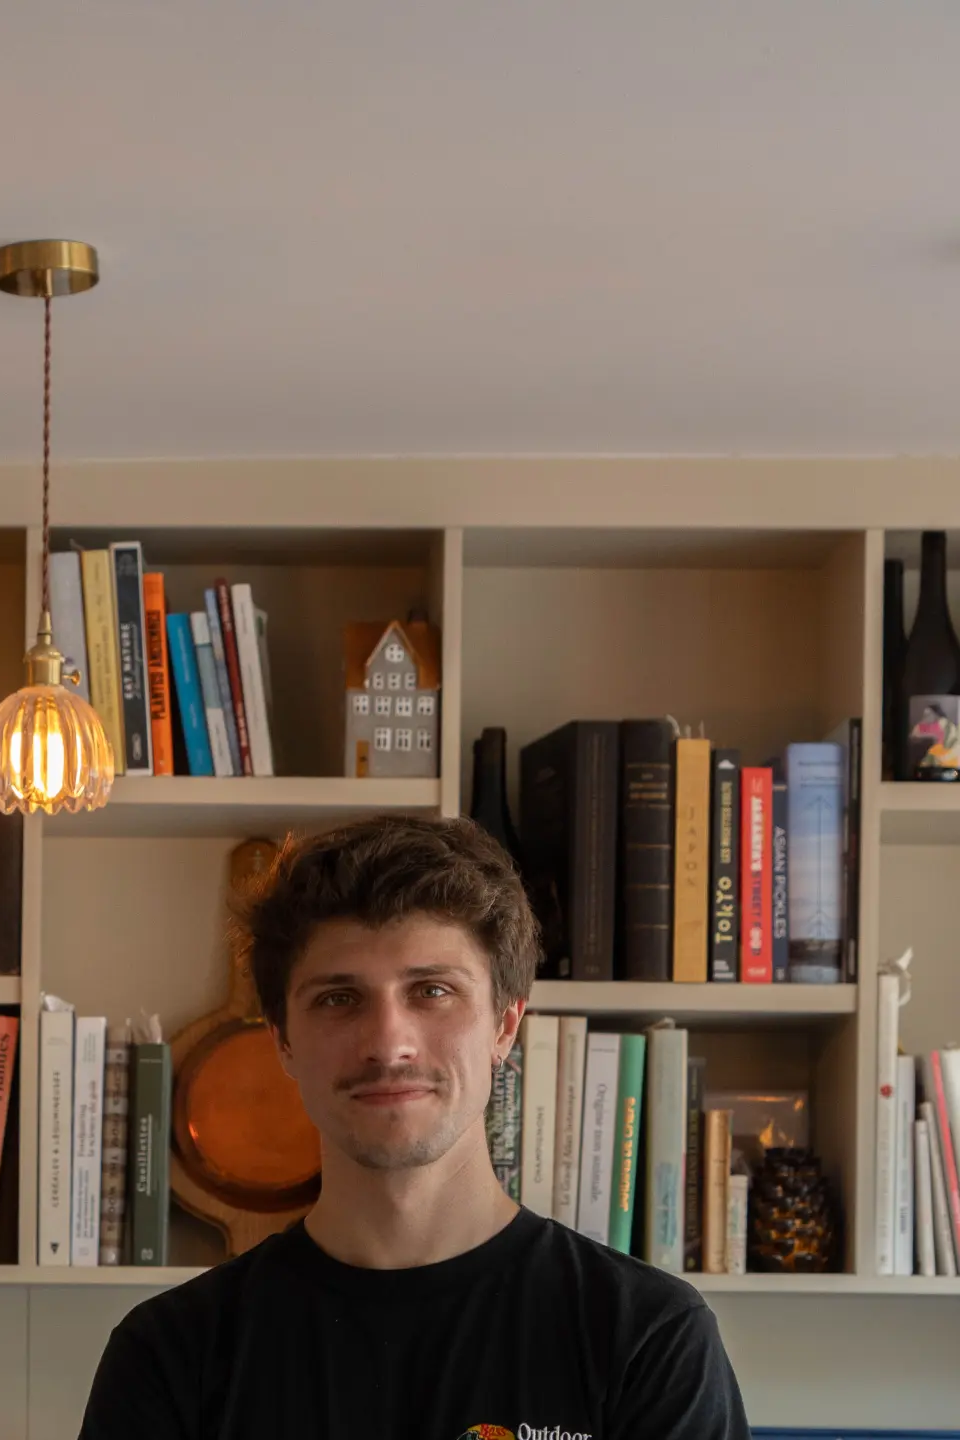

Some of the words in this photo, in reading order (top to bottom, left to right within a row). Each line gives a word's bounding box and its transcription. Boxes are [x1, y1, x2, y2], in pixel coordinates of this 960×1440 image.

[120, 622, 132, 672] NATURE
[123, 676, 134, 700] EAT
[774, 826, 785, 872] ASIAN
[774, 875, 785, 939] PICKLES
[595, 1083, 609, 1127] Origine
[136, 1117, 148, 1193] Cueillettes
[533, 1105, 545, 1183] CHAMPIGNONS
[594, 1130, 604, 1151] non
